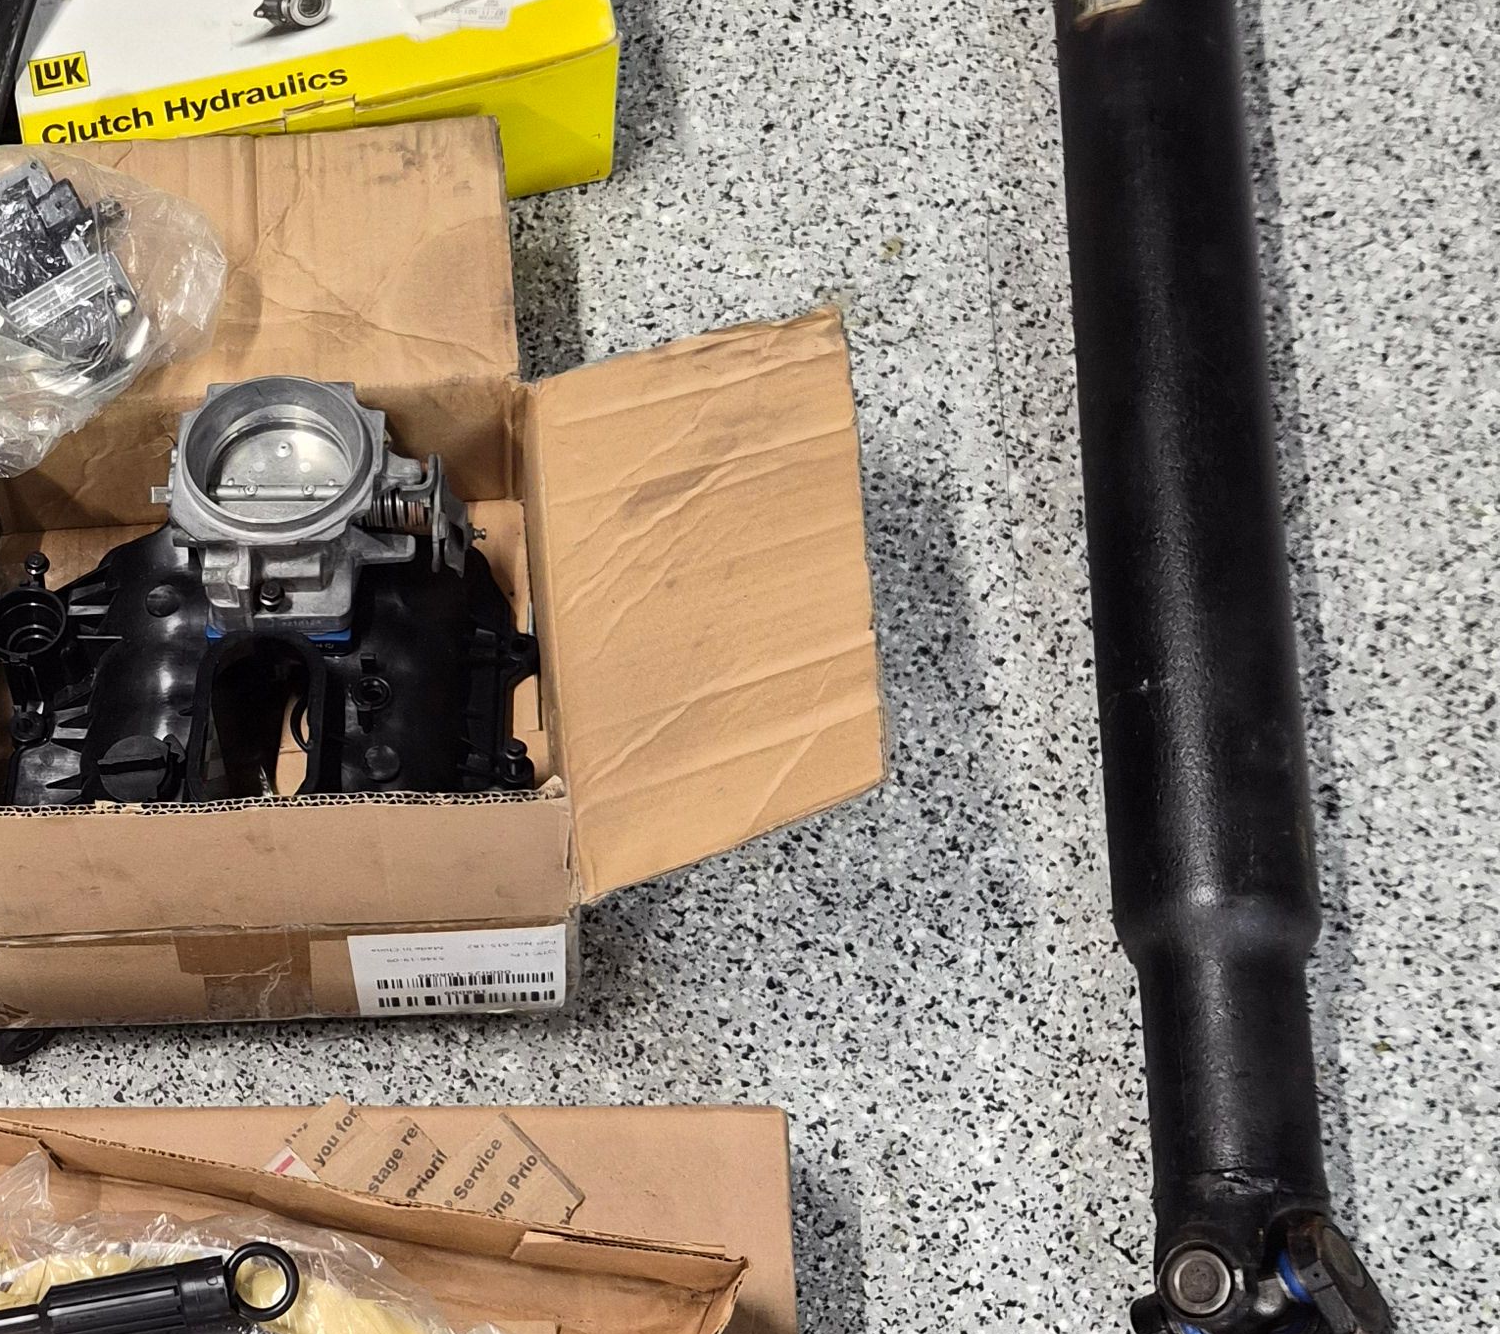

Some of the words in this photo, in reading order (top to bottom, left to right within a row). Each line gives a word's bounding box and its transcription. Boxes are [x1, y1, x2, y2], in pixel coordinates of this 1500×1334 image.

[41, 107, 155, 143] Clutch
[164, 67, 349, 122] Hydraulics
[313, 1139, 340, 1167] you
[453, 1136, 503, 1201] Service
[507, 1154, 539, 1191] Prio
